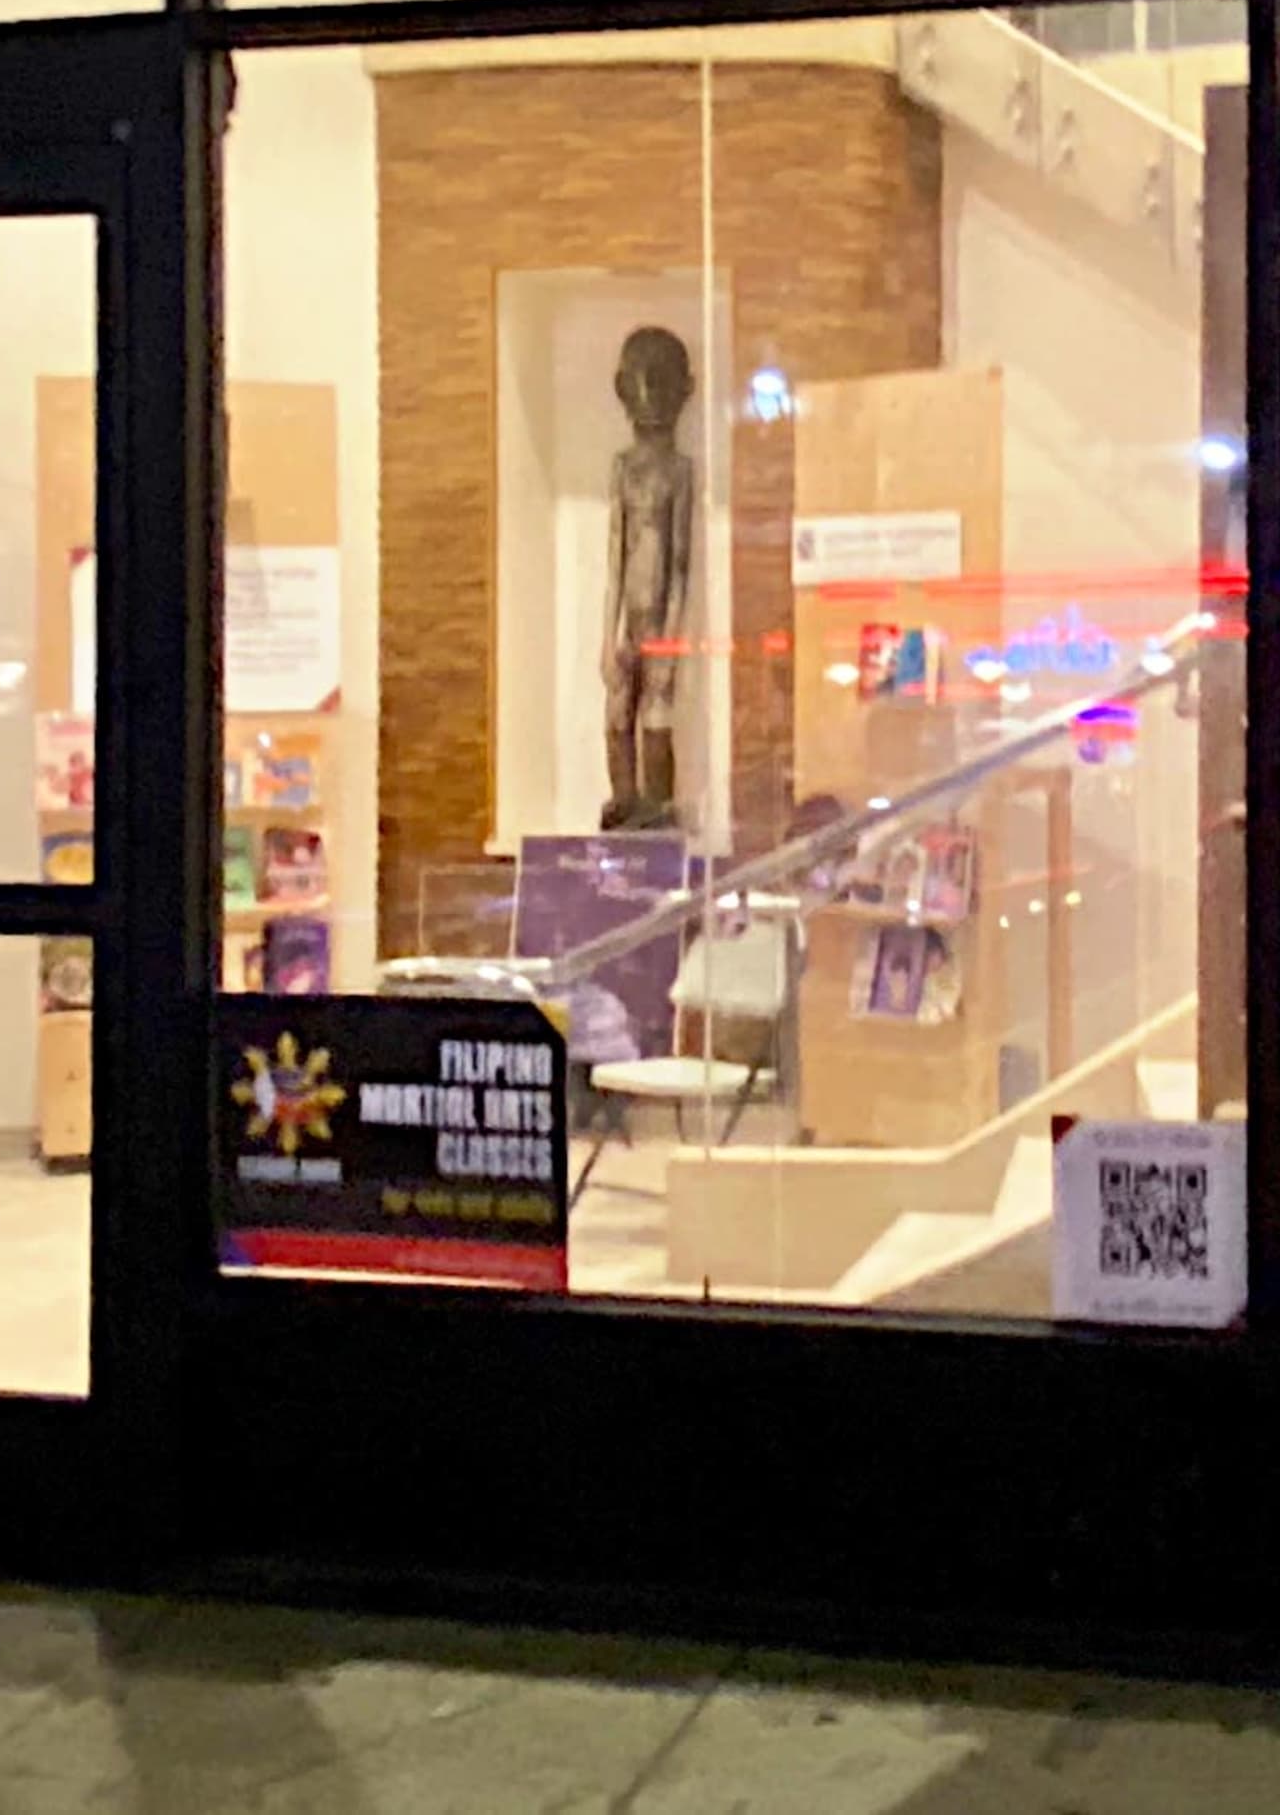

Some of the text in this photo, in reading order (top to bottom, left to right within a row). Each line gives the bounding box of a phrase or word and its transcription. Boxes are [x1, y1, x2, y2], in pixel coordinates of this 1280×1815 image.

[439, 1039, 553, 1086] FILIPINO
[358, 1082, 553, 1134] MARTIAL ARTS
[436, 1131, 553, 1180] CLASSES
